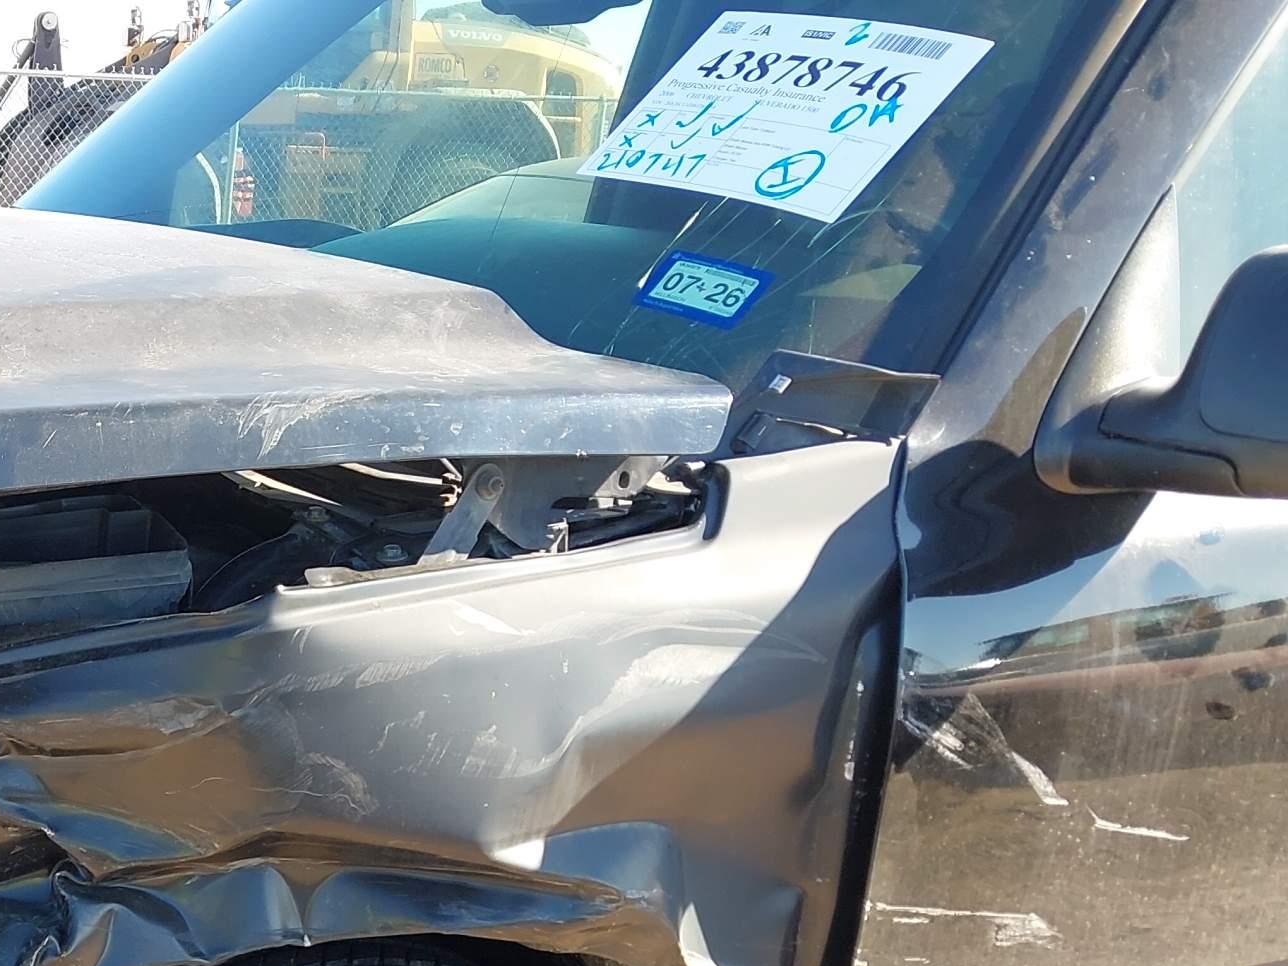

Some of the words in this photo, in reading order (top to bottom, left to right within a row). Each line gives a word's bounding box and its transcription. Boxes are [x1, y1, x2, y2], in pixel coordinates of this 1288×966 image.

[449, 29, 503, 41] VOLVO
[418, 57, 452, 73] ROMCO
[697, 49, 922, 101] 43878746
[667, 78, 725, 93] Progressive
[726, 83, 769, 97] Casualty
[772, 87, 827, 102] Insurance
